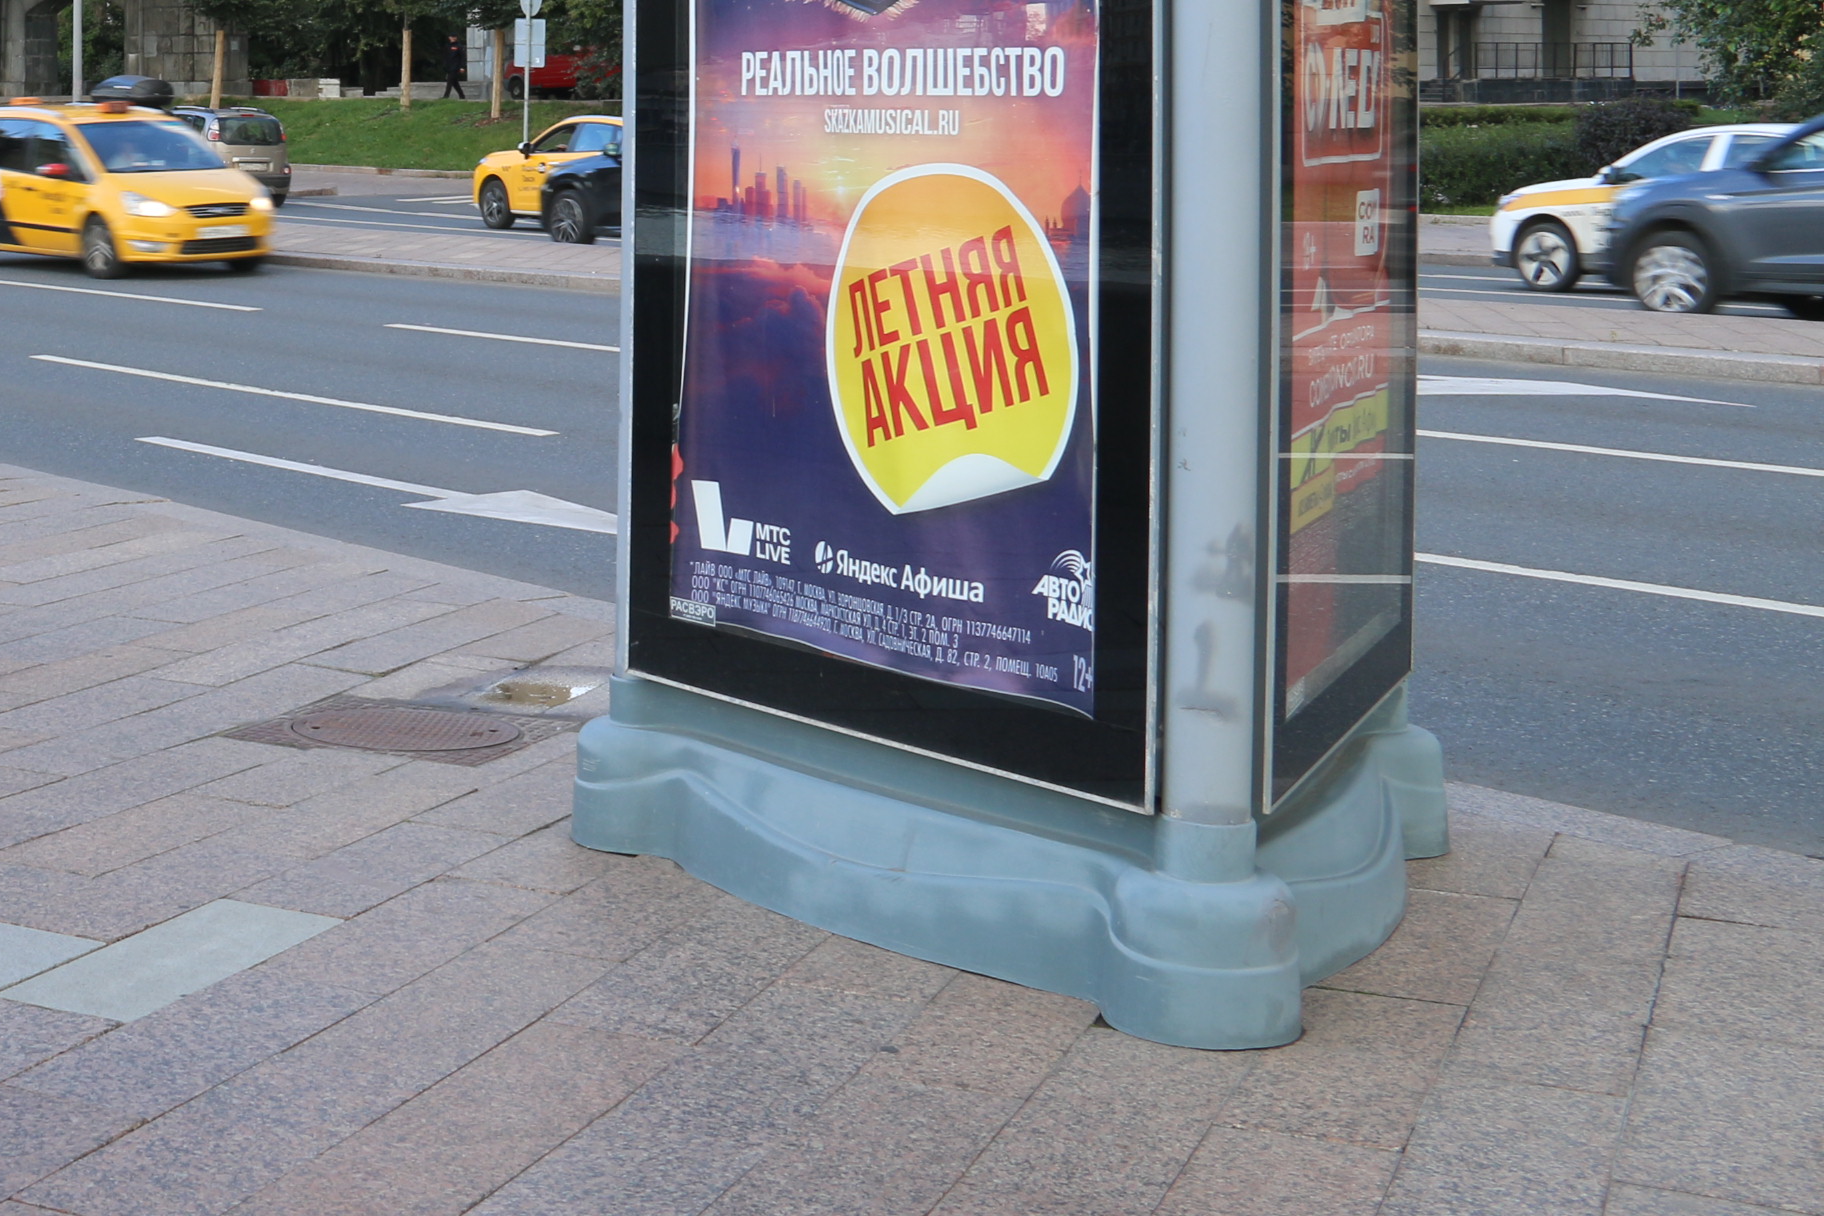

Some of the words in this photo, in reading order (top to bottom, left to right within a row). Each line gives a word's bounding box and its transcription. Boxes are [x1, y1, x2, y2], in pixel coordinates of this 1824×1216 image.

[741, 51, 855, 97] РЕАЛЬНОЕ
[863, 46, 1065, 98] ВОЛШЕБСТВО
[824, 108, 960, 136] SKAZKAMUSICAL.RU
[848, 224, 1028, 359] ЛЕТНЯЯ
[861, 305, 1050, 448] АКЦИЯ
[755, 522, 791, 546] МТС
[756, 540, 791, 565] LIVE
[836, 549, 898, 588] Яндекс
[900, 564, 984, 603] Афиша
[1031, 574, 1081, 603] АВТО
[670, 599, 714, 619] РАСВЭРО
[921, 628, 927, 643] 2
[952, 633, 959, 649] 3
[941, 616, 963, 634] ОГРН
[966, 620, 1031, 645] 1137746647114
[963, 651, 980, 668] СТР.
[995, 656, 1032, 680] ПОМЕЩ.
[1073, 654, 1094, 693] 12+
